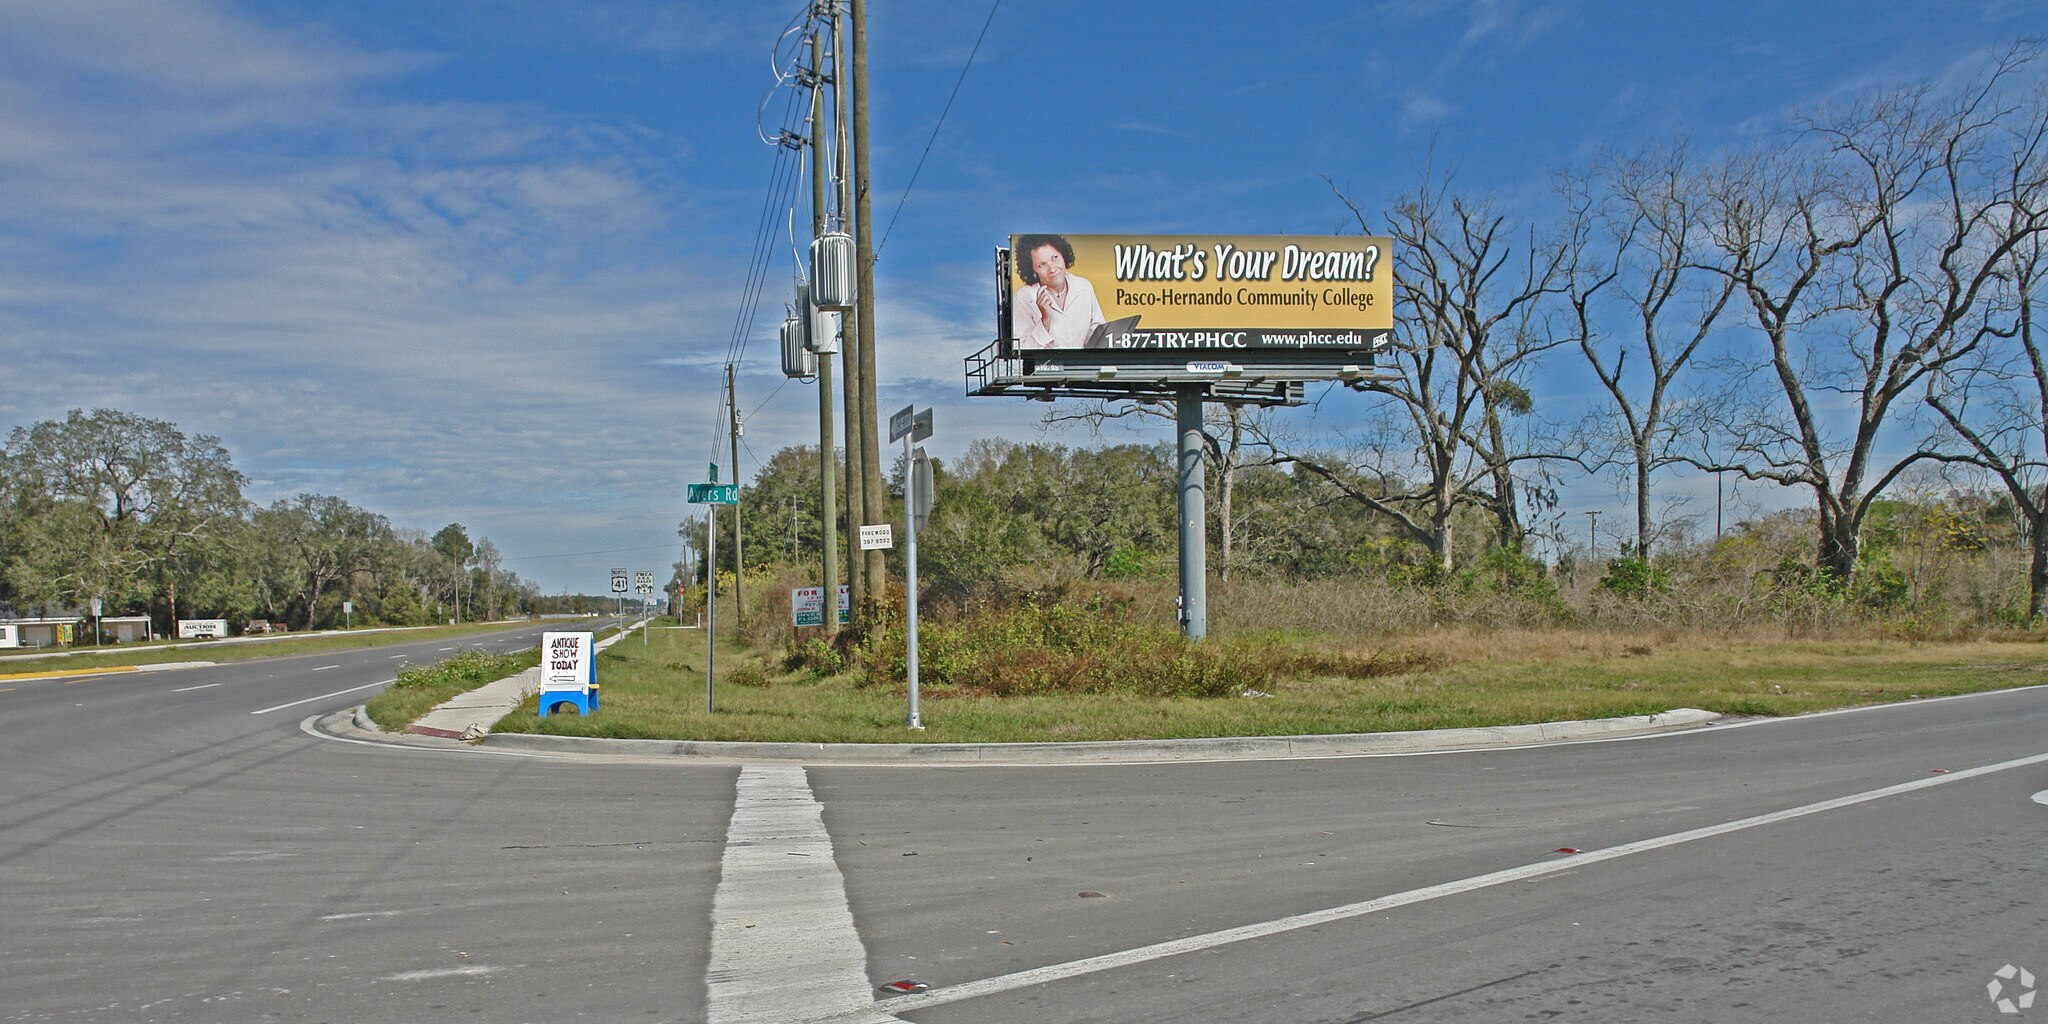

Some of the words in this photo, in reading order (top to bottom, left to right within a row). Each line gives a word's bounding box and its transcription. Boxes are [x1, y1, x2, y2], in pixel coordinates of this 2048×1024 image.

[1114, 244, 1206, 281] What's
[1214, 244, 1277, 281] Your
[1281, 244, 1379, 281] Dream?
[1115, 287, 1233, 306] Pasco-Hernando
[1236, 287, 1318, 311] Community
[1322, 287, 1374, 311] College
[1105, 332, 1248, 349] 1-877-TRY-PHCC
[1261, 331, 1362, 348] www.phcc.edu
[688, 487, 719, 503] Ayers
[725, 487, 738, 502] Rd
[615, 580, 625, 588] 41
[551, 637, 579, 648] ANTIQUE
[552, 648, 578, 659] SHOW
[550, 660, 579, 670] TODAY
